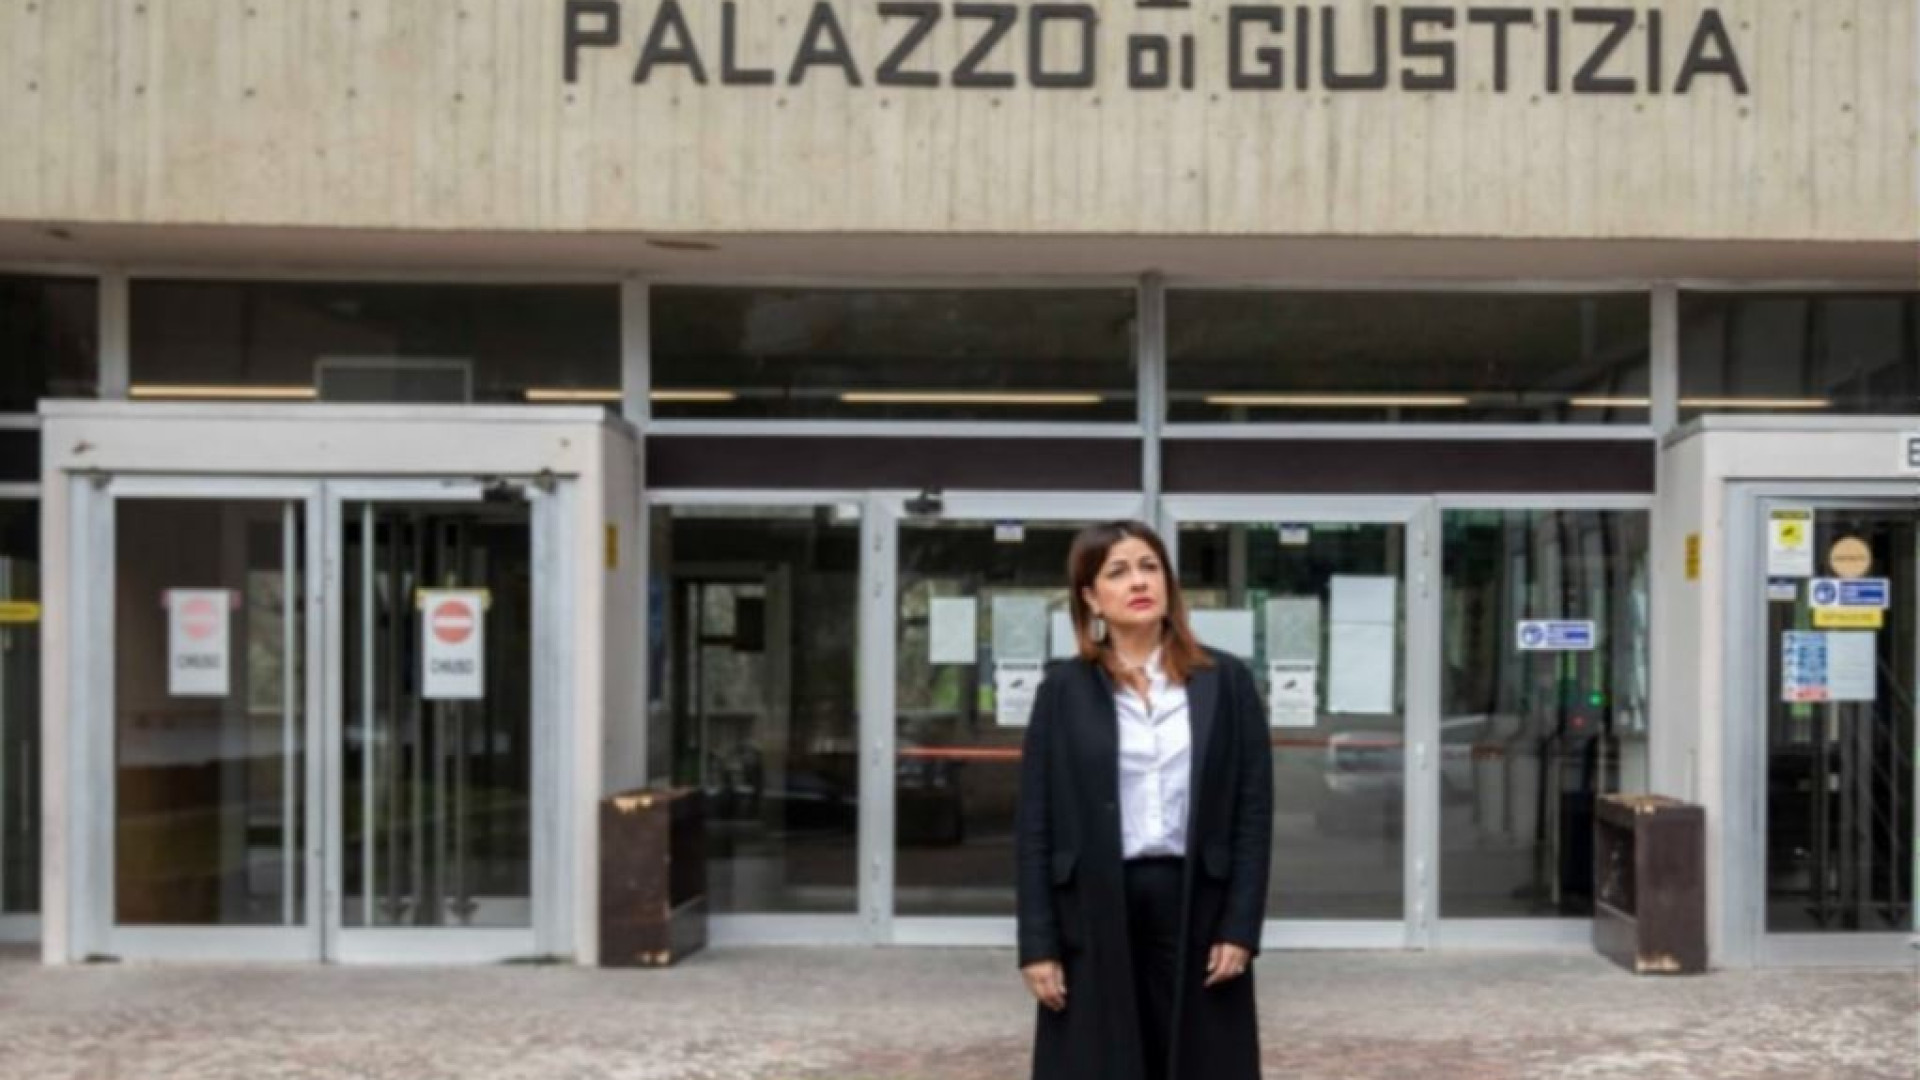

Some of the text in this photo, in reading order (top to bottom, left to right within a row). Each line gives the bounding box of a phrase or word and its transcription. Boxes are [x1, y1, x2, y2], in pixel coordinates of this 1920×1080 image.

[563, 0, 1748, 95] PALAZZO DI GIUSTIZIA
